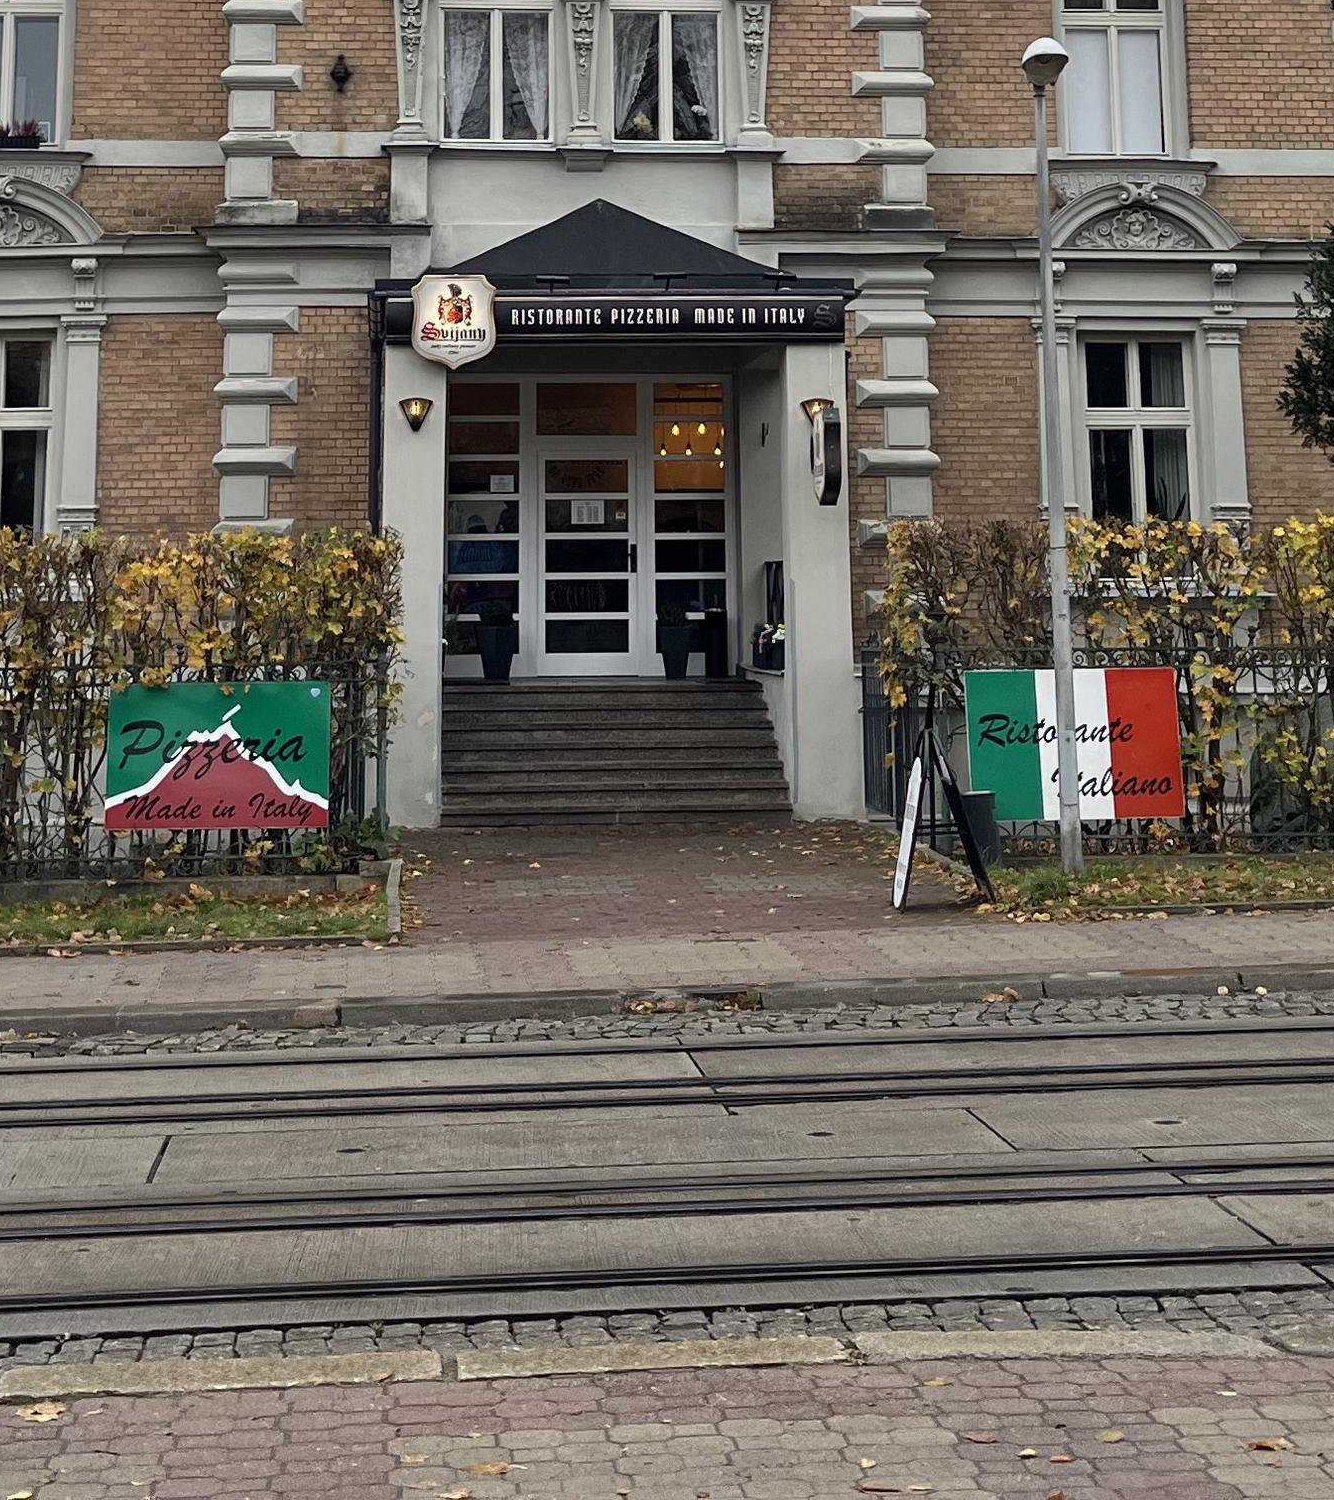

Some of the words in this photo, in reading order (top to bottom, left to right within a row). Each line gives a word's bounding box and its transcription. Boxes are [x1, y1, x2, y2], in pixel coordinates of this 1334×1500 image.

[421, 321, 486, 342] Svijany
[511, 308, 602, 325] RISTORANTE
[610, 308, 680, 325] PIZZERIA
[694, 307, 735, 324] MADE
[742, 307, 756, 324] IN
[764, 307, 805, 324] ITALY
[977, 713, 1134, 747] Ristoante
[119, 719, 307, 781] Pizzeria
[1051, 766, 1173, 798] aliano
[123, 794, 202, 821] Made
[212, 795, 236, 818] in
[247, 793, 313, 825] Italy
